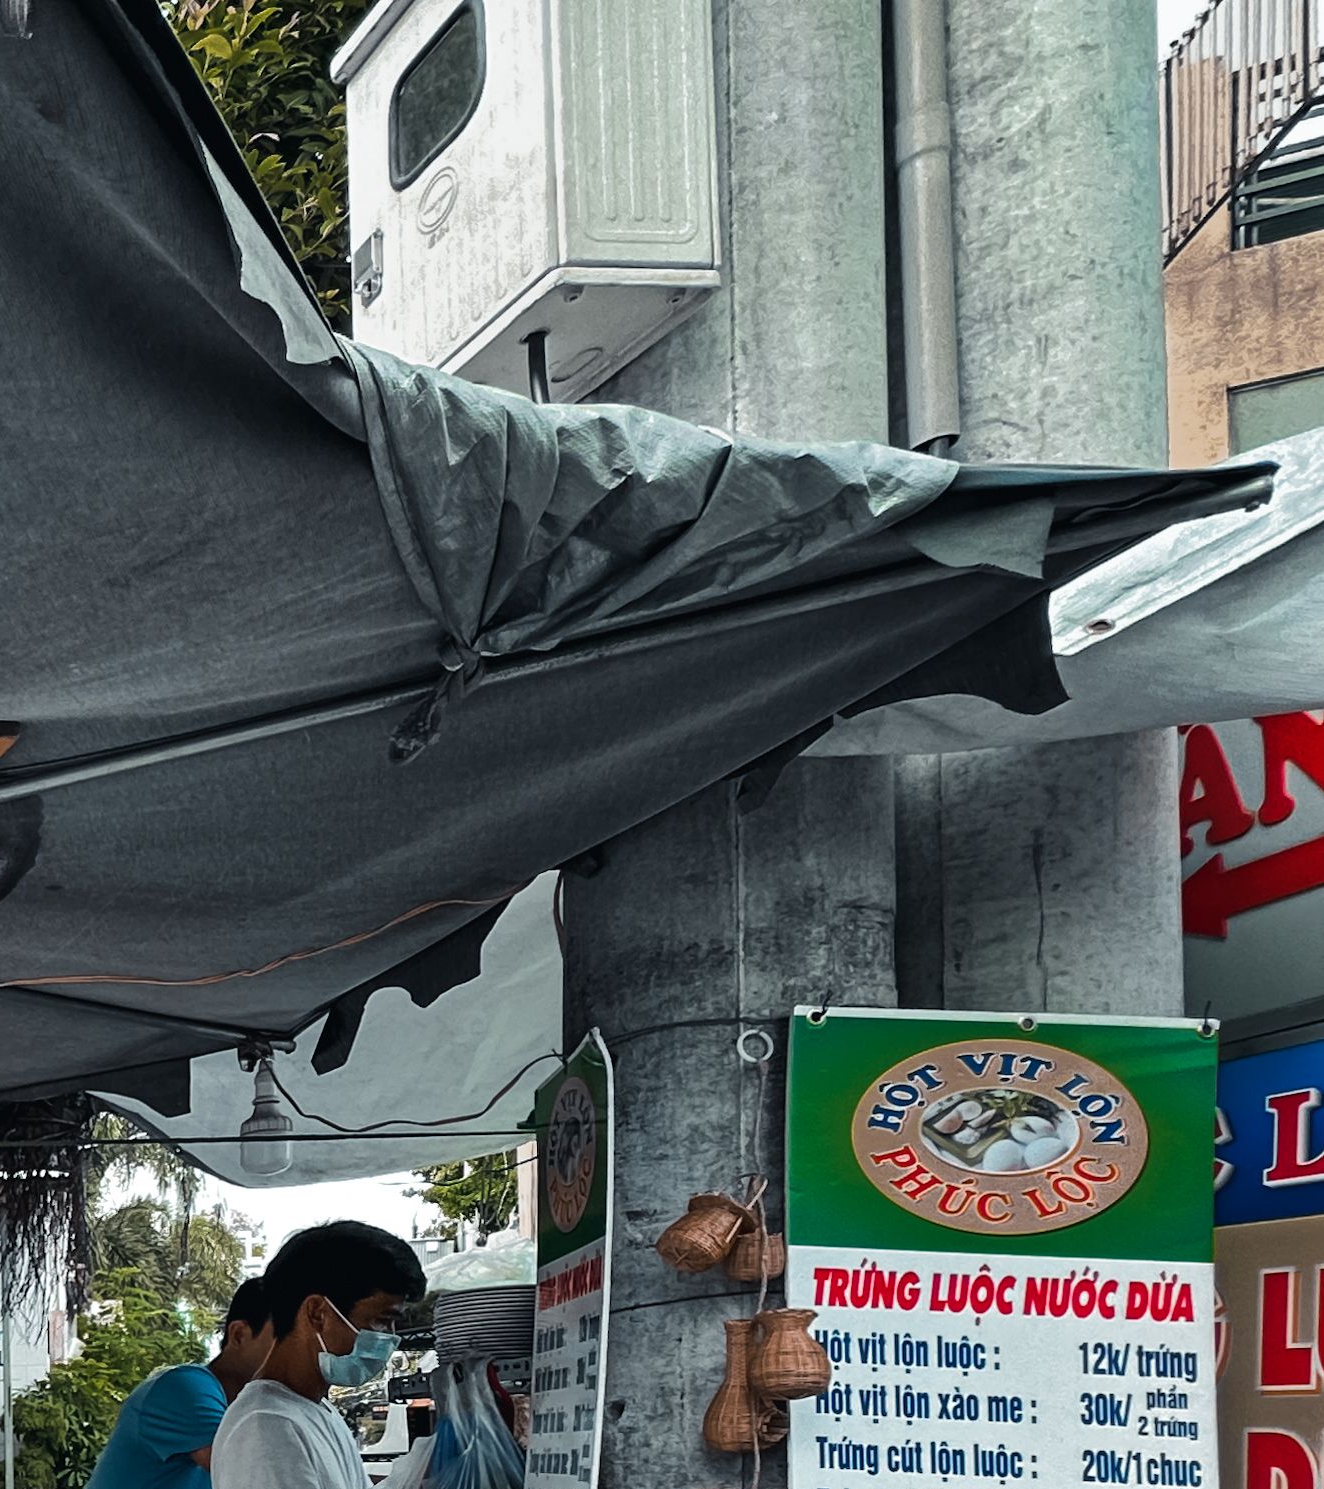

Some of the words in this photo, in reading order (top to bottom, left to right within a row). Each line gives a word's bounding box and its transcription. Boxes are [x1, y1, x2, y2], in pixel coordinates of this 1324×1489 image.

[867, 1064, 945, 1134] HỘT
[956, 1052, 1056, 1084] VỊT
[1054, 1073, 1129, 1147] LỘN
[869, 1145, 1015, 1224] PHÚC
[1022, 1156, 1120, 1220] LỘC
[813, 1258, 921, 1311] TRỨNG
[929, 1265, 1017, 1325] LUỘC
[1023, 1267, 1119, 1319] NƯỚC
[1125, 1271, 1195, 1322] DỪA
[858, 1332, 887, 1372] vịt
[894, 1334, 928, 1374] lộn
[937, 1335, 986, 1377] luộc
[1079, 1342, 1130, 1377] 12k/
[1136, 1344, 1198, 1383] trứng
[859, 1385, 888, 1424] vịt
[895, 1385, 930, 1427] lộn
[938, 1386, 980, 1421] xào
[988, 1396, 1022, 1423] me
[1080, 1392, 1132, 1428] 30k/
[1146, 1385, 1189, 1411] phần
[1138, 1416, 1149, 1437] 2
[1154, 1415, 1199, 1441] trứng
[815, 1436, 879, 1476] Trứng
[887, 1437, 924, 1475] cút
[930, 1439, 966, 1482] lộn
[973, 1441, 1024, 1485] luộc
